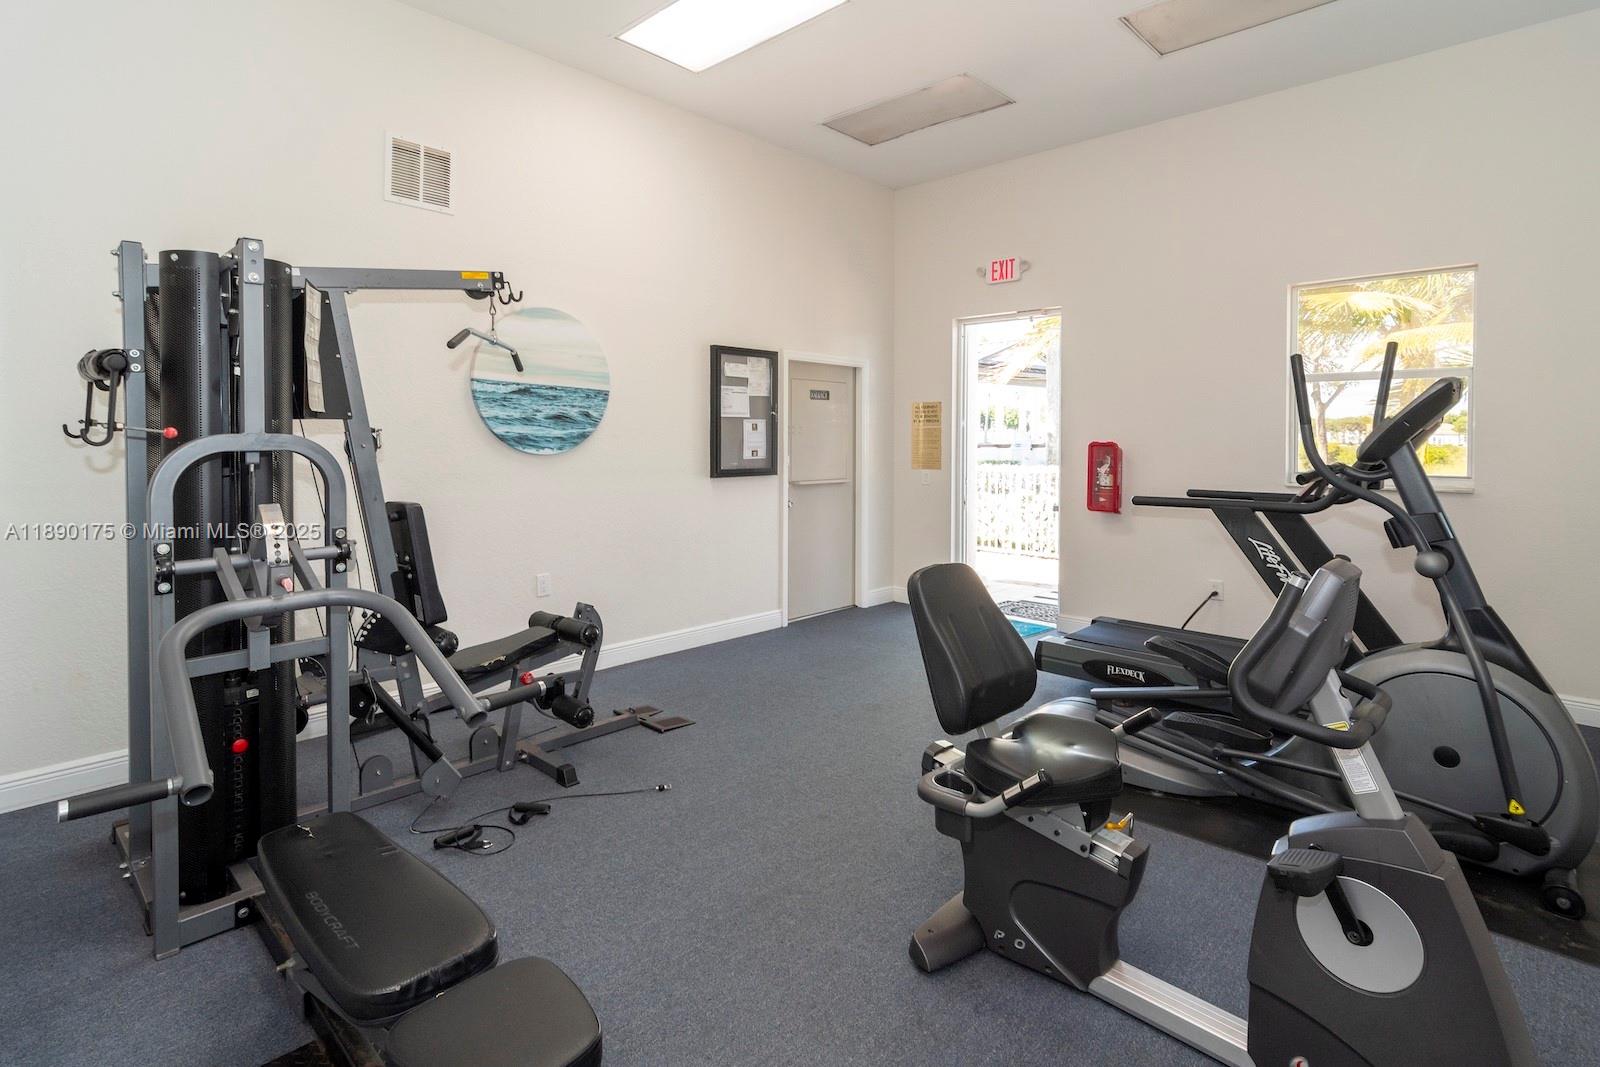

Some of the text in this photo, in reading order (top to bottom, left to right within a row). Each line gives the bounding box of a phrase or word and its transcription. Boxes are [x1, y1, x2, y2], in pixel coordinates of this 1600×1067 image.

[991, 258, 1015, 282] EXIT
[1106, 664, 1146, 683] FLEXDECK
[304, 890, 361, 950] BODYCRAFT
